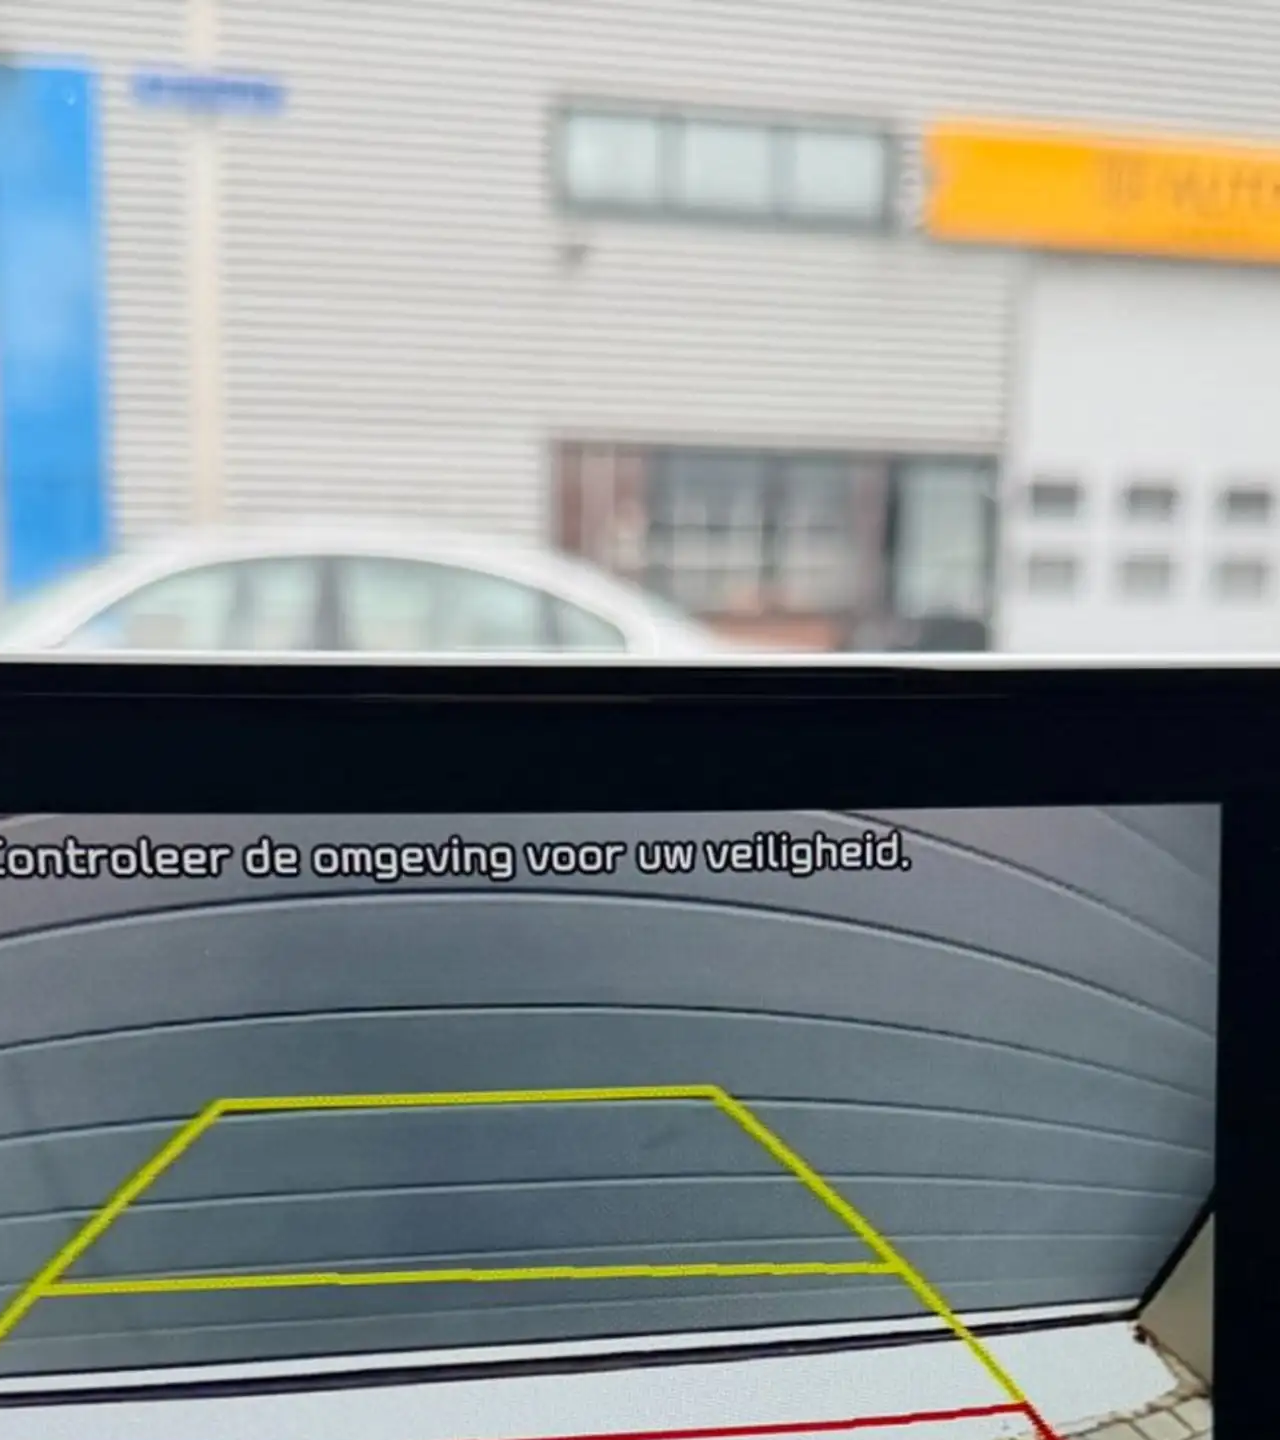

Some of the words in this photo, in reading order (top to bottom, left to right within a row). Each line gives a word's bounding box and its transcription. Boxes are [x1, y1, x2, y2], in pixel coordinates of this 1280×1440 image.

[242, 835, 298, 877] de
[312, 833, 515, 880] omgeving
[525, 842, 625, 873] voor
[637, 838, 695, 872] uw
[705, 831, 912, 876] veiligheid.
